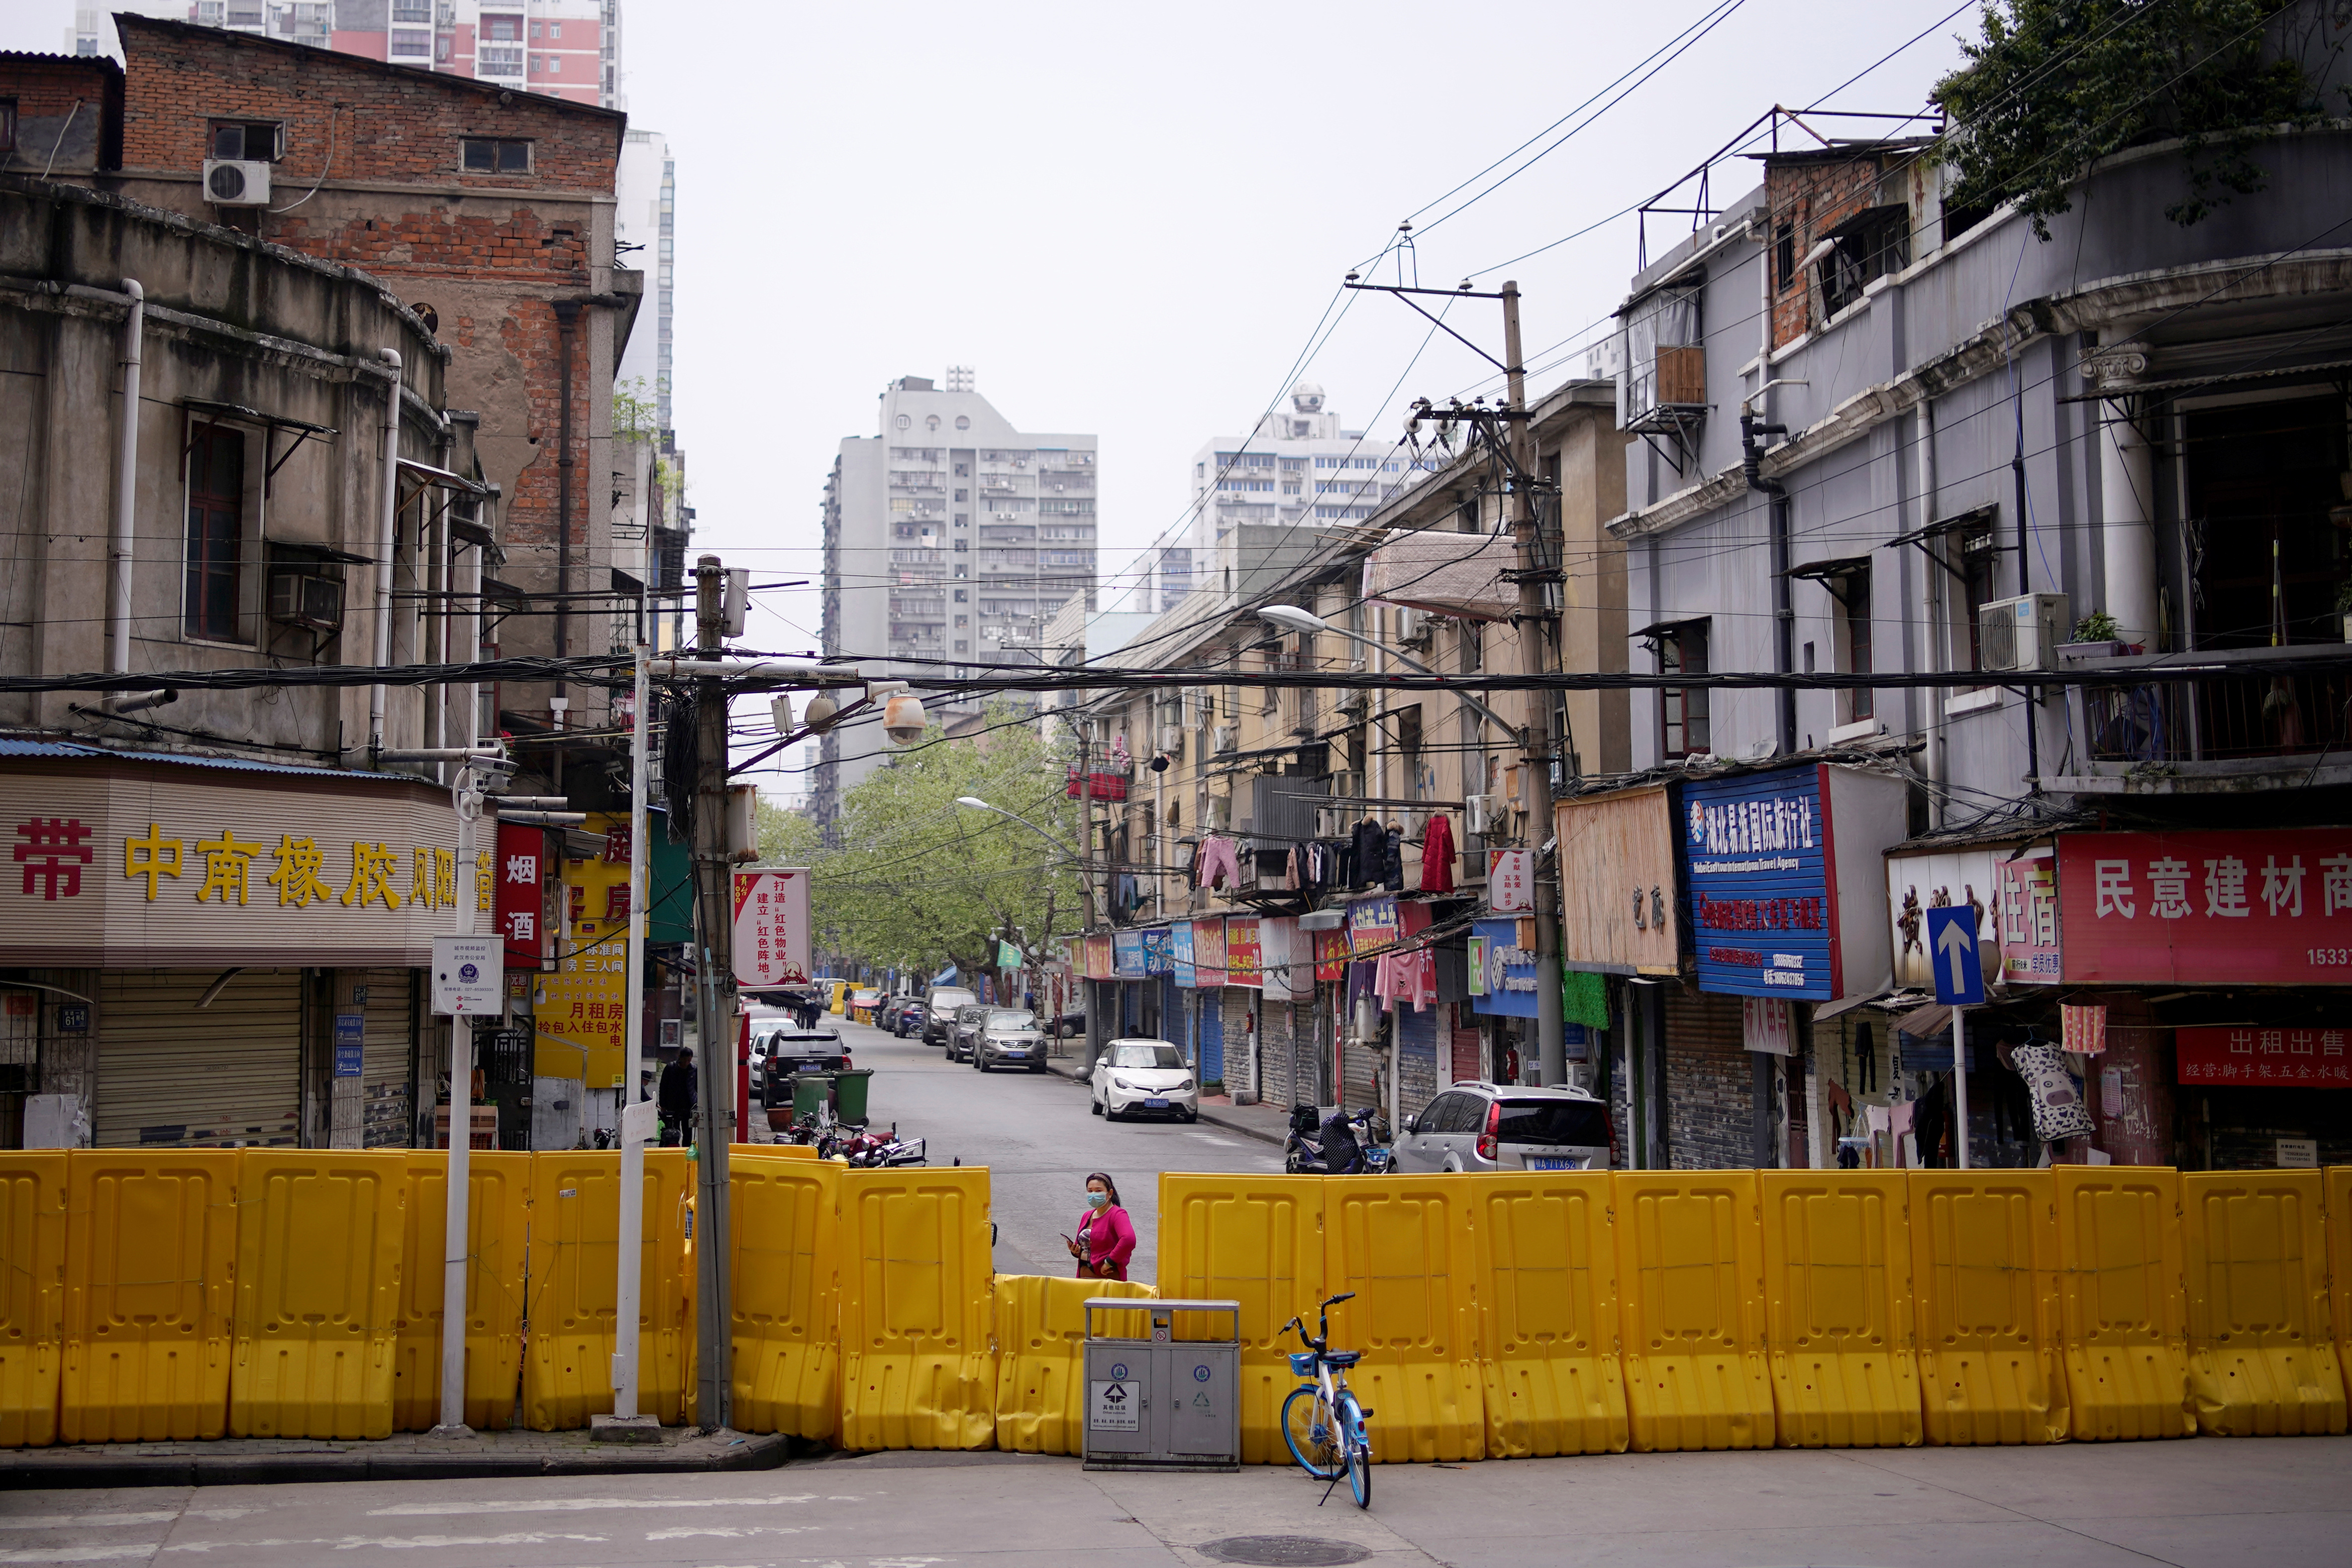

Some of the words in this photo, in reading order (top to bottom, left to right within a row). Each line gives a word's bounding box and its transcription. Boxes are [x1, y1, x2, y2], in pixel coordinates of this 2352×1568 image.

[1706, 796, 1813, 854] 湖北易游国际旅行社
[14, 817, 93, 900] 带
[1513, 857, 1520, 871] 奉献
[1777, 856, 1799, 871] Agency
[125, 823, 401, 910] 中南橡胶
[410, 846, 494, 911] 凤阳管
[1504, 875, 1511, 888] 互助
[1514, 875, 1521, 888] 友爱
[505, 855, 536, 940] 烟酒
[1504, 892, 1512, 906] 进步
[1999, 864, 2057, 947] 住宿
[774, 881, 786, 967] 打造“红色物业”
[757, 893, 770, 980] 建立“红色阵地”
[585, 943, 624, 957] 标准间
[584, 960, 624, 973] 三人间
[2032, 953, 2060, 975] 学员优惠
[569, 1003, 624, 1019] 月租房
[65, 1016, 74, 1025] 61
[538, 1020, 622, 1034] 拎包入住包水
[1745, 995, 1789, 1049] 成人用品
[610, 1034, 622, 1046] 电
[2230, 1030, 2345, 1056] 出租出售
